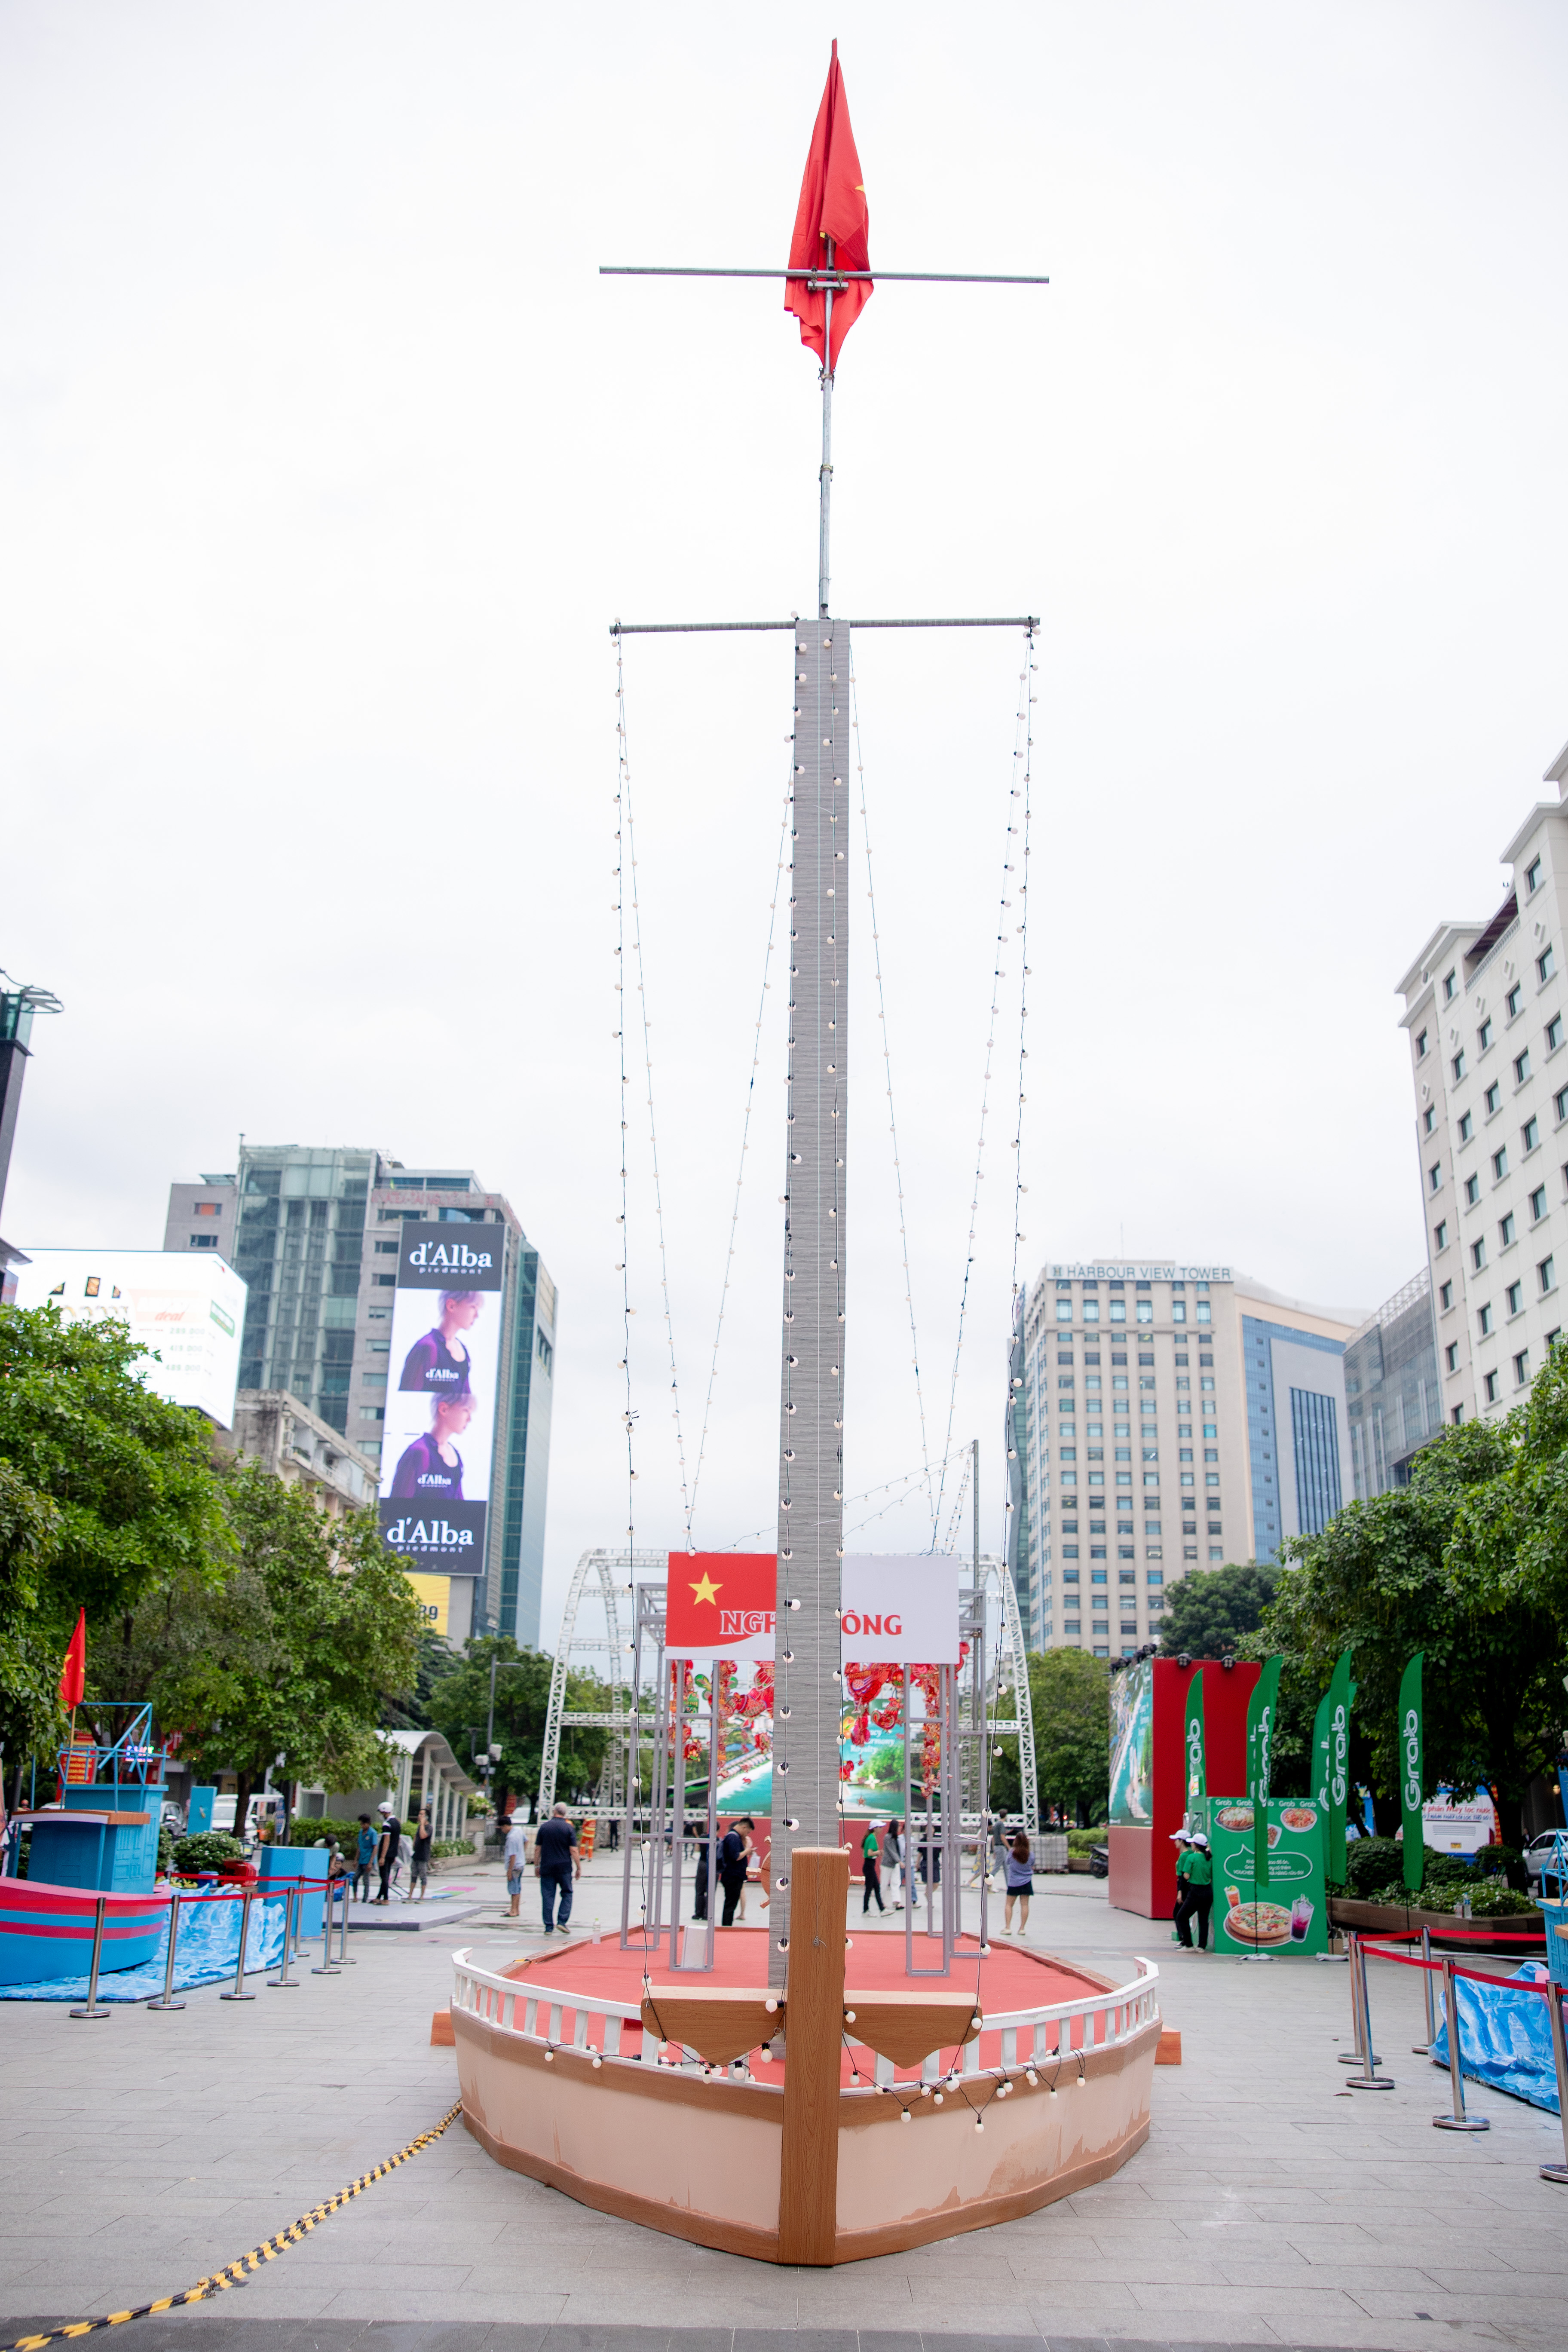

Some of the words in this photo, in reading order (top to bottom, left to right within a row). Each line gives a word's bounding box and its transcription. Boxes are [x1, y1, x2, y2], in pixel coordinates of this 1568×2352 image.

[409, 1241, 493, 1268] d'Alba
[419, 1267, 482, 1275] piedmont
[1067, 1266, 1135, 1279] HARBOUR
[1139, 1267, 1175, 1279] VIEW
[1180, 1268, 1231, 1280] TOWER
[425, 1367, 459, 1379] d'Alba
[417, 1473, 452, 1485] d'Alba
[386, 1517, 475, 1545] d'Alba
[397, 1544, 463, 1553] piedmont
[720, 1610, 776, 1635] NGH
[1331, 1704, 1346, 1806] Grab
[1403, 1709, 1421, 1811] Grab
